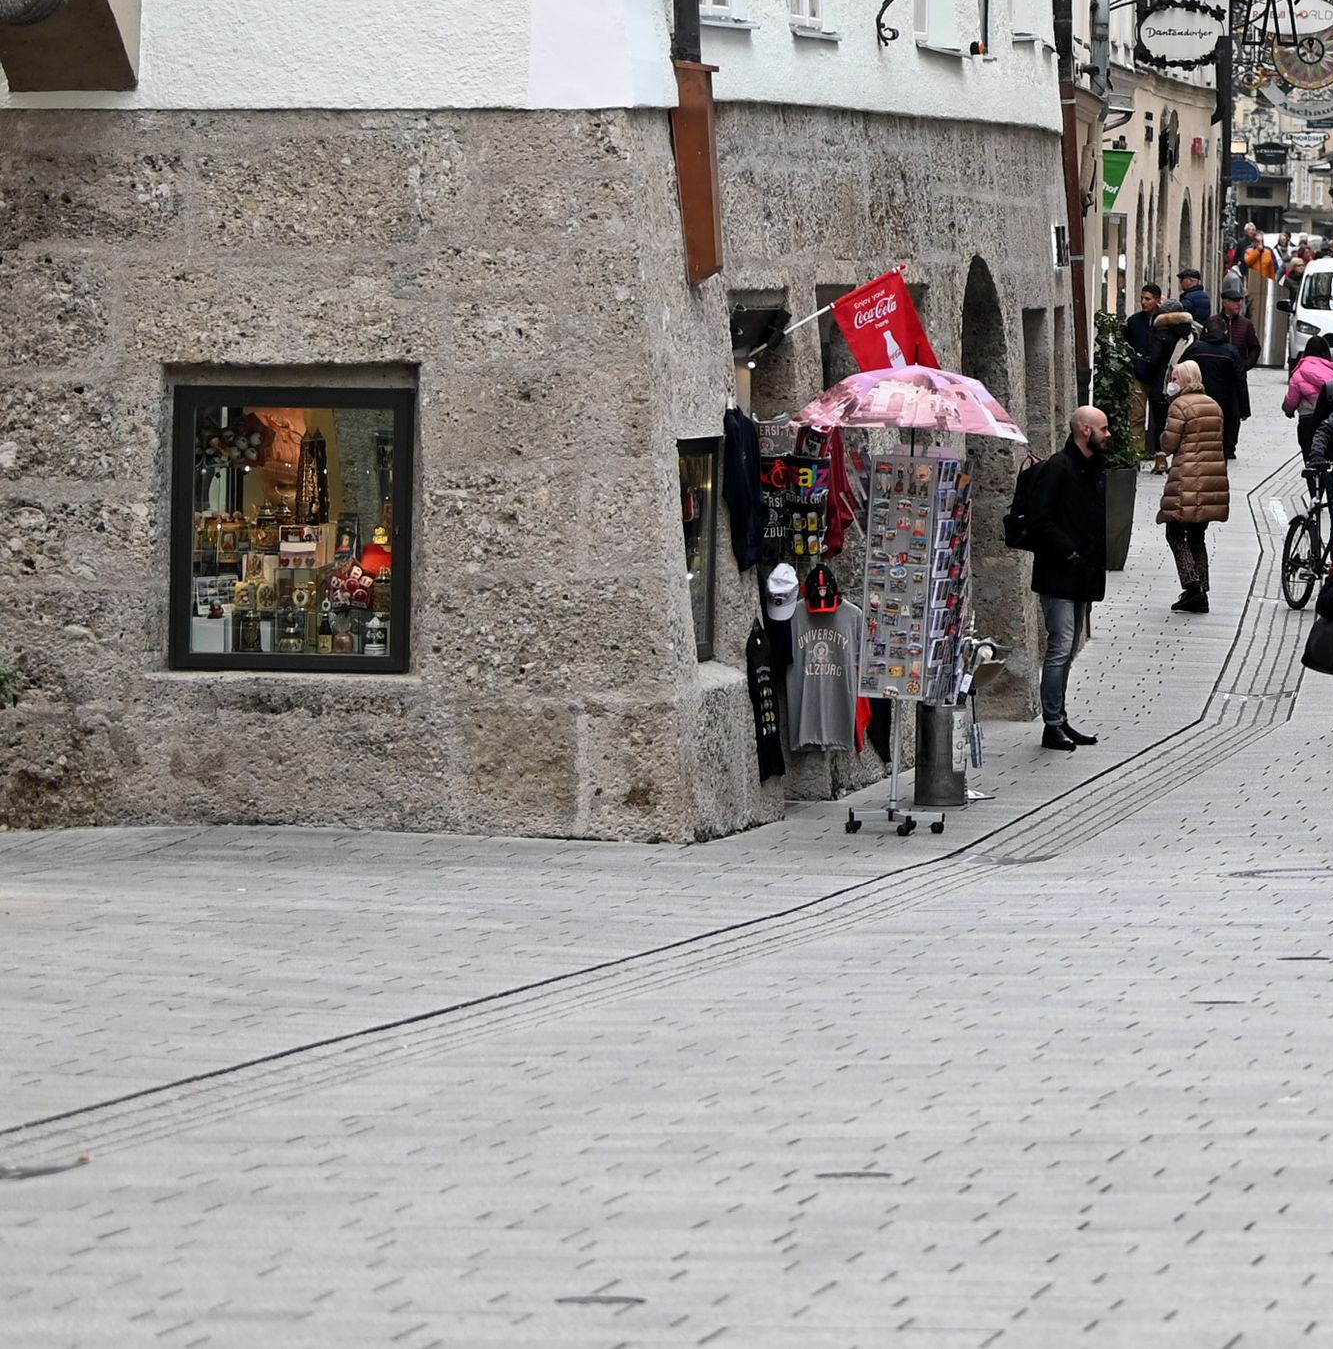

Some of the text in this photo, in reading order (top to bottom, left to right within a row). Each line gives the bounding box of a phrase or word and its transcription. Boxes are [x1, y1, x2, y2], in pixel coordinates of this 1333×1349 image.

[1145, 27, 1213, 39] Dantendorfer
[853, 289, 886, 310] Enjoy your
[874, 319, 889, 330] here
[798, 628, 849, 650] UNIVERSITY
